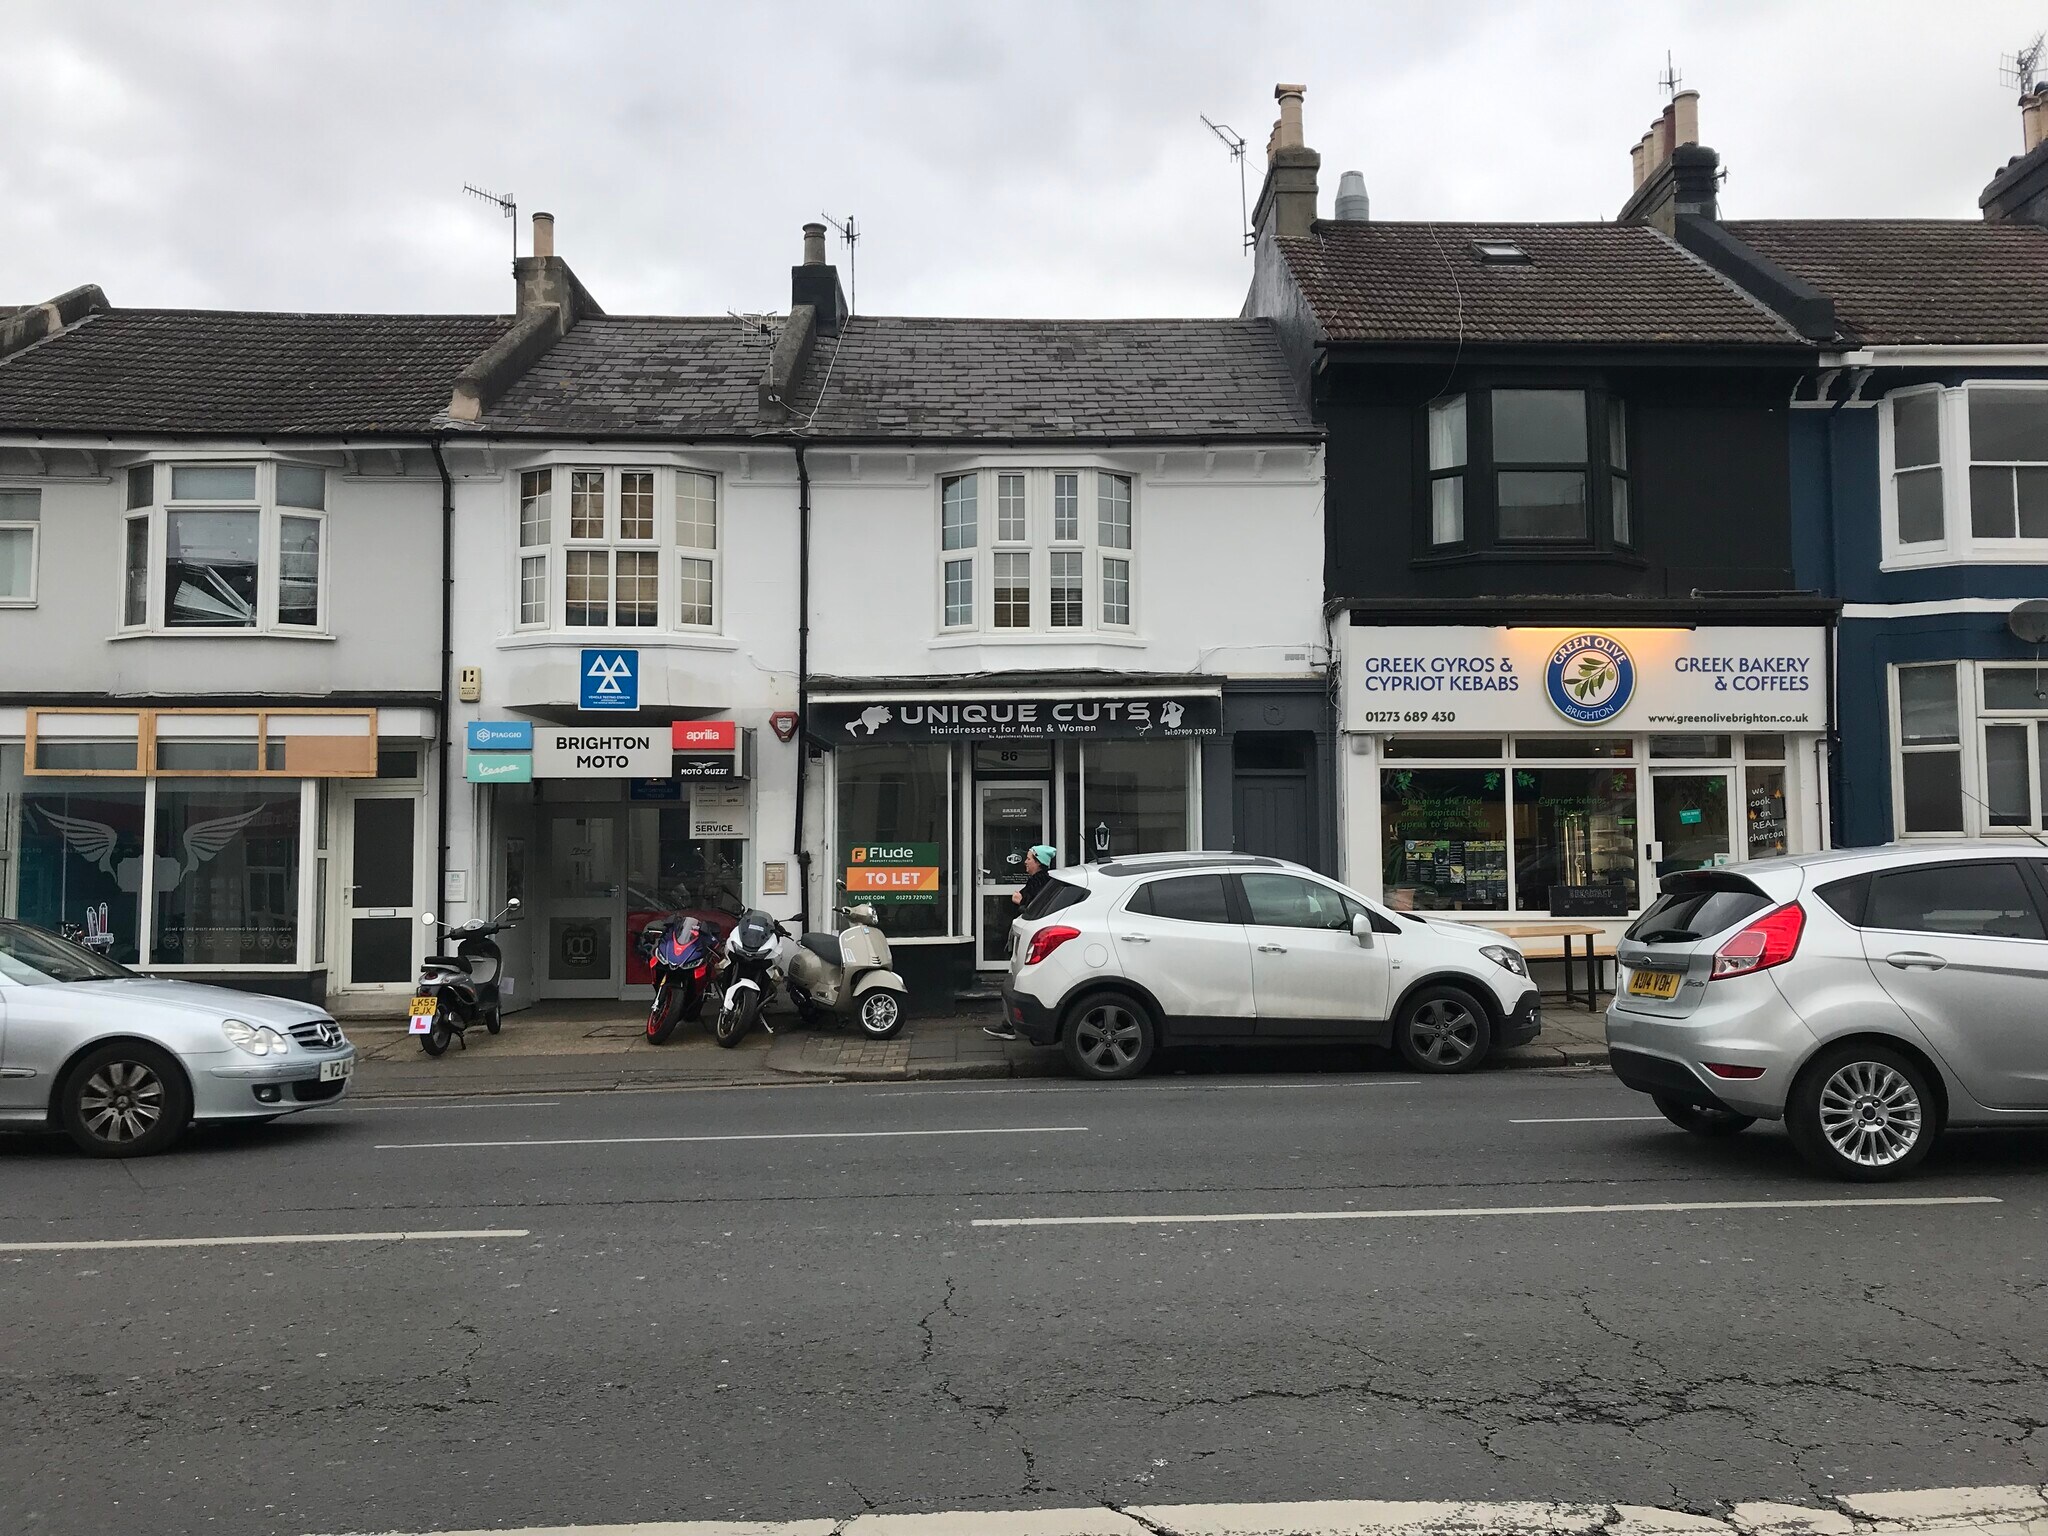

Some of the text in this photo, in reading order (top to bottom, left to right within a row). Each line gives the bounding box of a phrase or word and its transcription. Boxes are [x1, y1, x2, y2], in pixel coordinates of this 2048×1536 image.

[1553, 637, 1627, 664] GREEN OLIVE
[1365, 657, 1513, 672] GREEK GYROS &
[1675, 657, 1810, 672] GREEK BAKERY
[1365, 676, 1519, 691] CYPRIOT KEBABS
[1714, 676, 1809, 691] & COFFEES
[900, 702, 1150, 724] UNIQUE CUTS
[1365, 711, 1456, 722] 01273 689 430
[1564, 704, 1614, 720] BRIGHTON
[1648, 713, 1809, 724] www.greenolivebrighton.co.uk
[930, 723, 1097, 734] Hairdressers for Men & Women
[686, 729, 719, 741] aprilia
[556, 737, 650, 749] BRIGHTON
[577, 755, 629, 768] MOTO
[1001, 751, 1018, 761] 86
[479, 762, 520, 777] Vespa
[1752, 787, 1765, 795] we
[1401, 796, 1483, 808] Bringing the food
[1539, 796, 1574, 807] Cypriot
[1750, 796, 1771, 807] cook
[1401, 808, 1419, 817] and
[1422, 808, 1471, 818] hospitality
[1760, 810, 1772, 818] on
[695, 824, 733, 832] SERVICE
[1752, 819, 1778, 830] REAL
[1749, 827, 1786, 842] charcoal
[869, 847, 914, 858] Flude
[865, 872, 920, 885] TO LET
[1633, 973, 1653, 989] AU14
[415, 1018, 426, 1029] L
